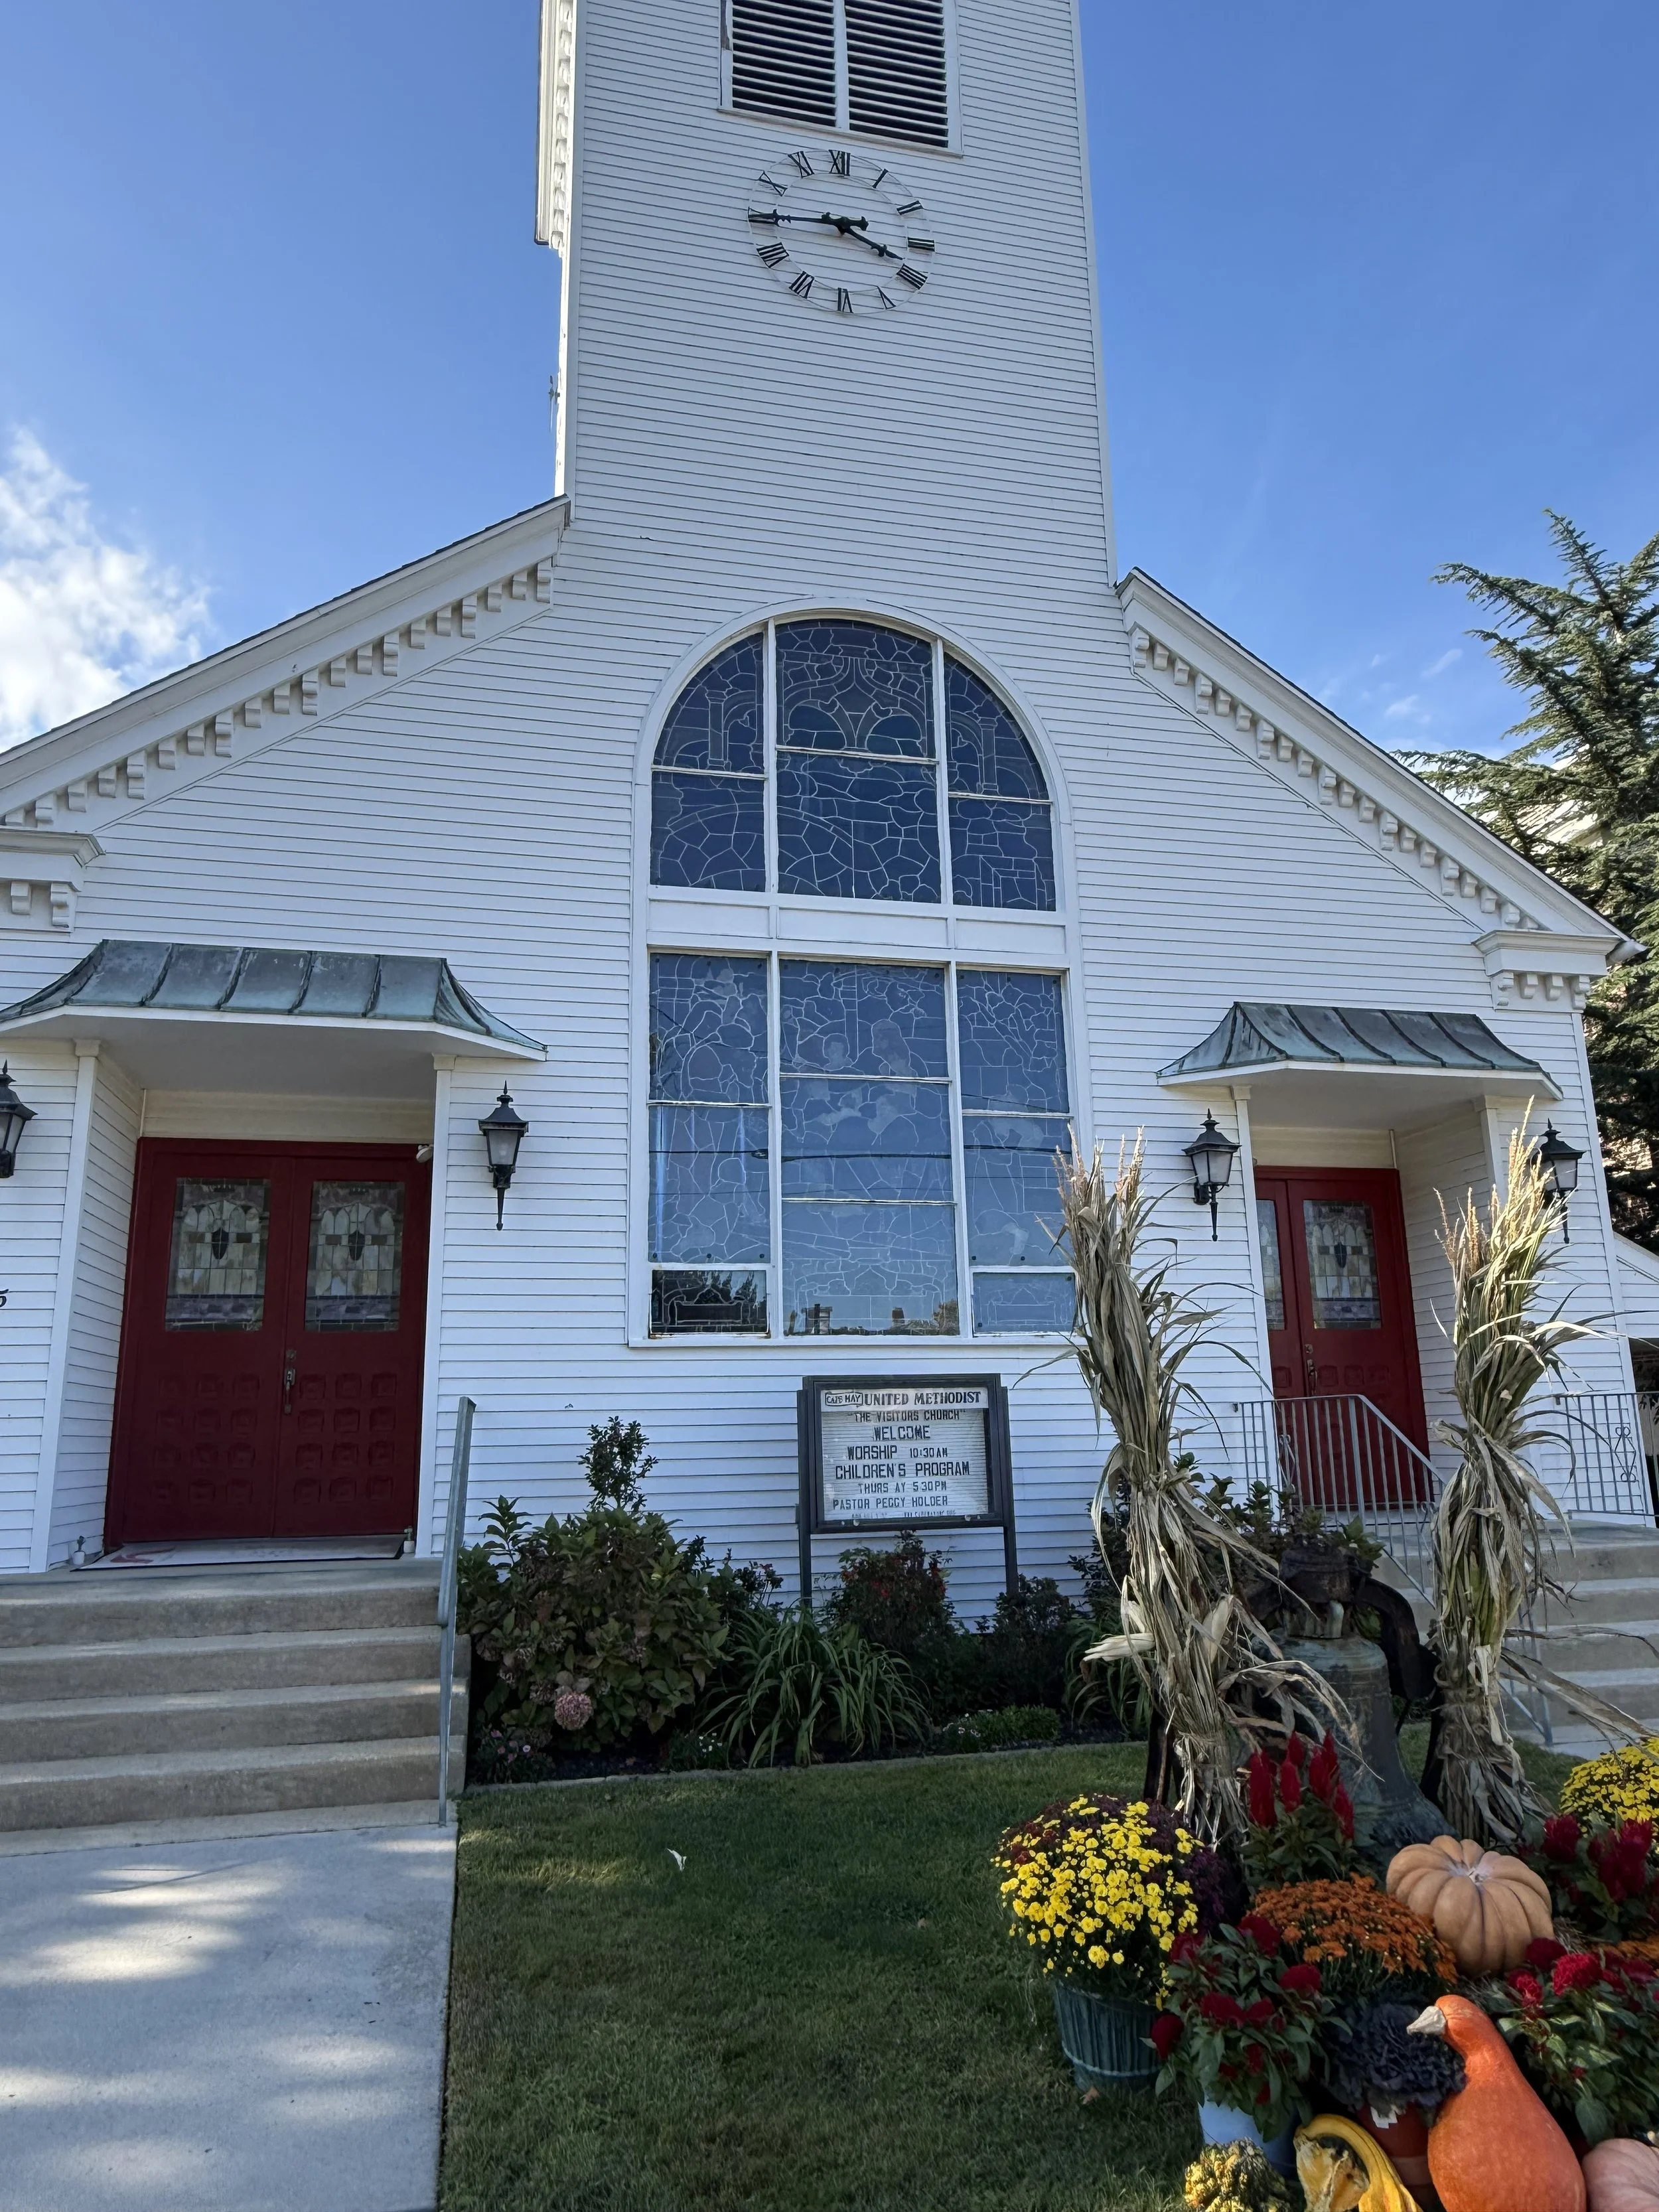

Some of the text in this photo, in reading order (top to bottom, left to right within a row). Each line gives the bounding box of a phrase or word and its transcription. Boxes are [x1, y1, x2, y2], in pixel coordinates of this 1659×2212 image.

[788, 151, 815, 178] XI
[828, 149, 851, 176] XII
[757, 170, 788, 196] X
[871, 169, 889, 188] I
[896, 200, 923, 215] II
[906, 236, 936, 252] III
[757, 242, 790, 268] VIII
[788, 270, 815, 299] VII
[837, 287, 853, 313] VI
[876, 285, 897, 309] V
[845, 1394, 861, 1403] MAY
[864, 1391, 981, 1406] UNITED METHODIST
[877, 1410, 919, 1423] VISITORS
[873, 1426, 931, 1441] WELCOME
[847, 1445, 898, 1460] WORSHIP
[835, 1461, 970, 1480] CHILDREN'S PROGRAM
[858, 1483, 889, 1494] THURS
[833, 1495, 948, 1510] PASTOR PEGGY HOLDER
